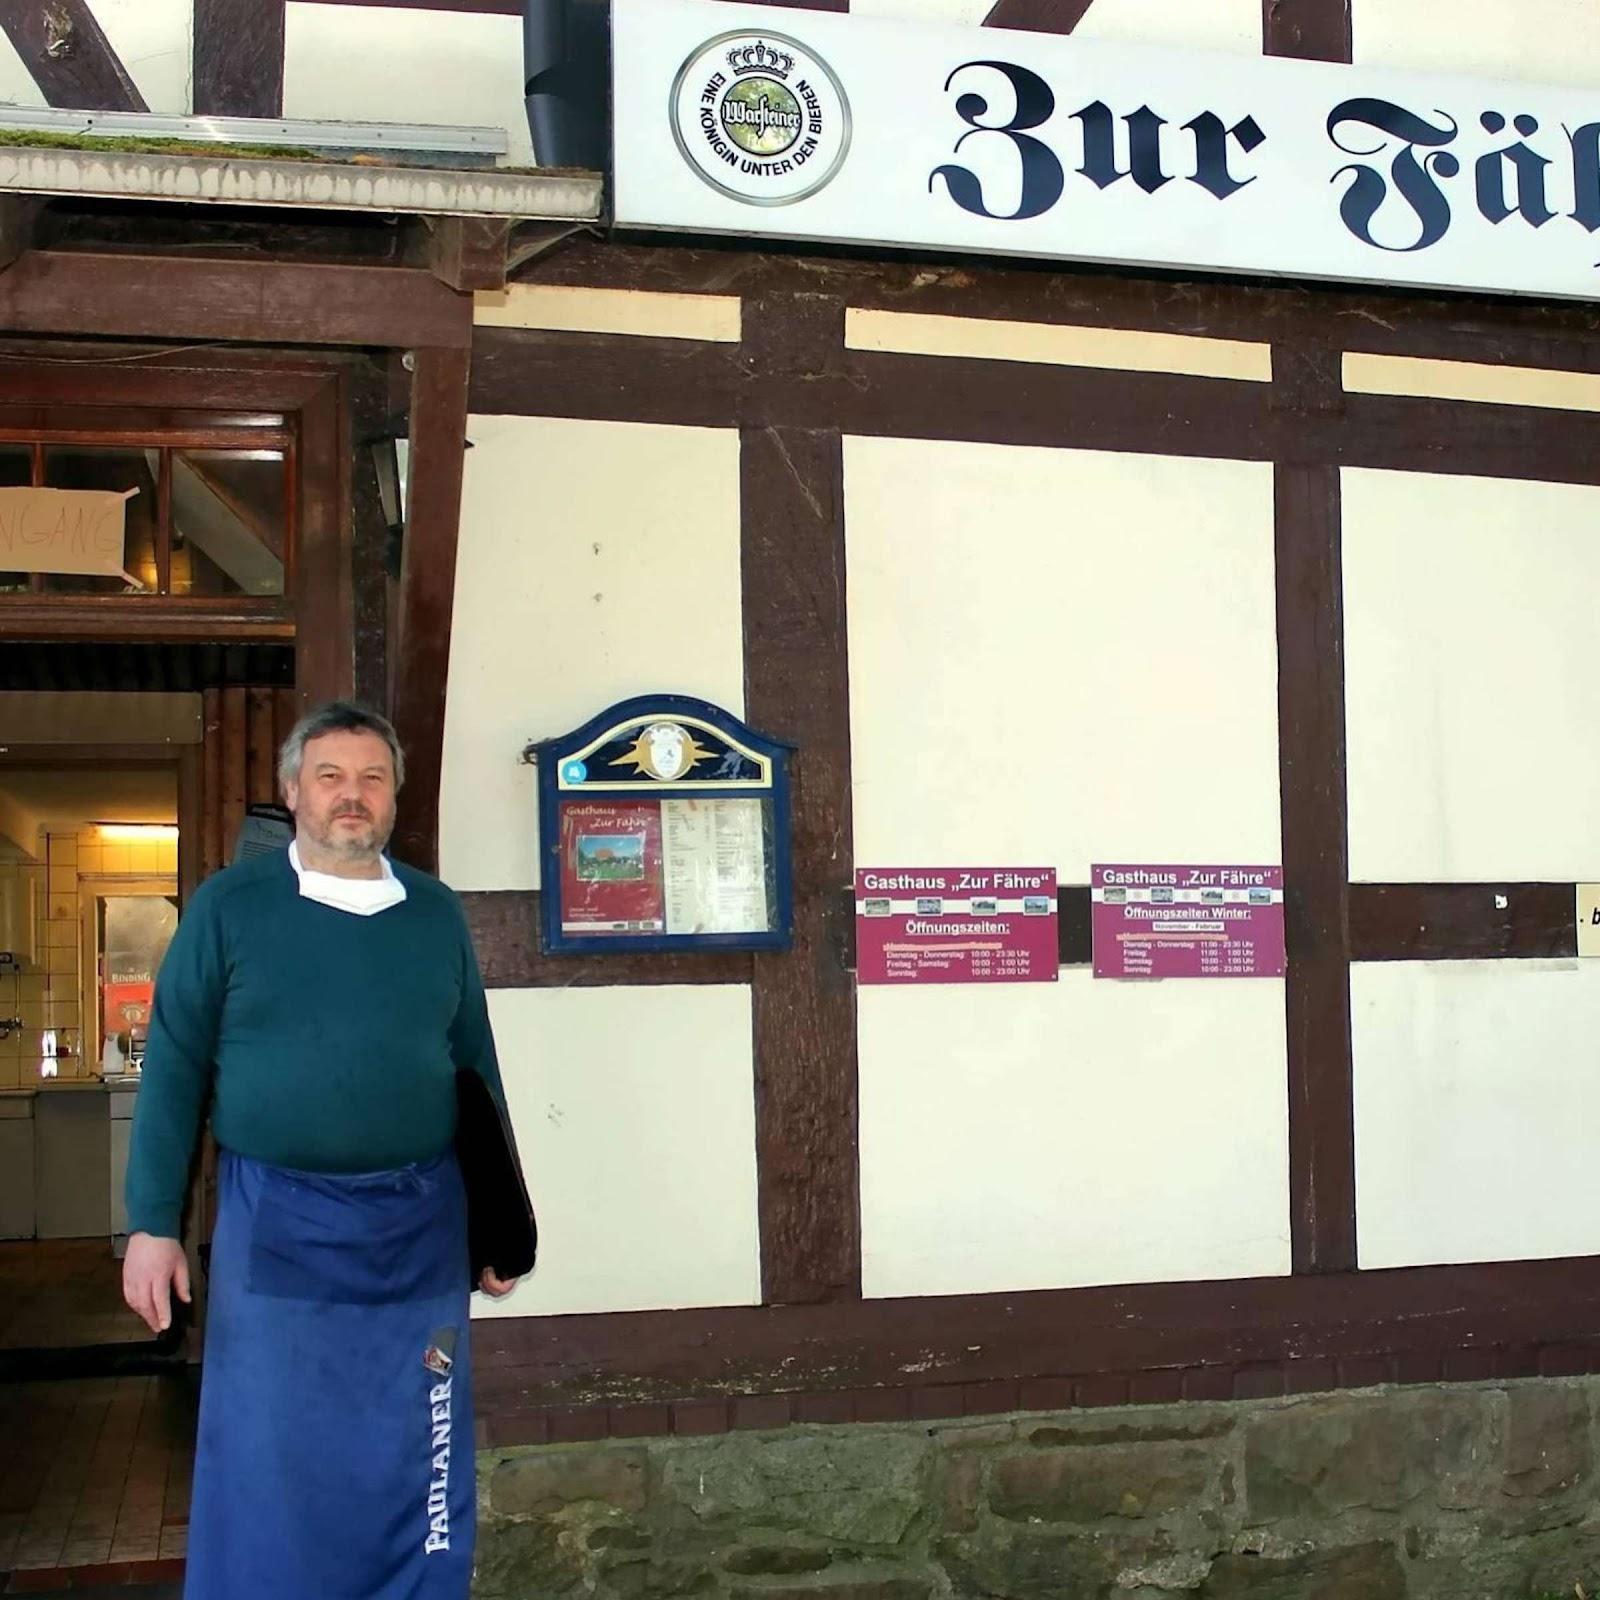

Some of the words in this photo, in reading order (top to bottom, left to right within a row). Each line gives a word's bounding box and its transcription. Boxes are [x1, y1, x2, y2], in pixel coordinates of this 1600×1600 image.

[701, 71, 727, 103] EINE
[796, 79, 822, 135] BIEREN
[700, 107, 739, 167] KÖNIGIN
[928, 60, 1267, 220] Zur
[793, 136, 818, 166] DEN
[740, 159, 794, 176] UNTER
[566, 805, 617, 815] Gasthaus
[864, 875, 946, 889] Gasthaus
[951, 874, 989, 891] „Zur
[993, 873, 1049, 889] Fähre“
[1102, 869, 1177, 884] Gasthaus
[1182, 870, 1216, 886] „Zur
[1220, 869, 1271, 884] Fähre“
[1124, 906, 1209, 919] Öffnungszeiten
[1211, 907, 1252, 918] Winter:
[905, 920, 1011, 935] Öffnungszeiten:
[1016, 949, 1031, 957] Uhr
[1017, 958, 1031, 966] Uhr
[1017, 967, 1031, 975] Uhr
[425, 1377, 453, 1555] PAULANER
